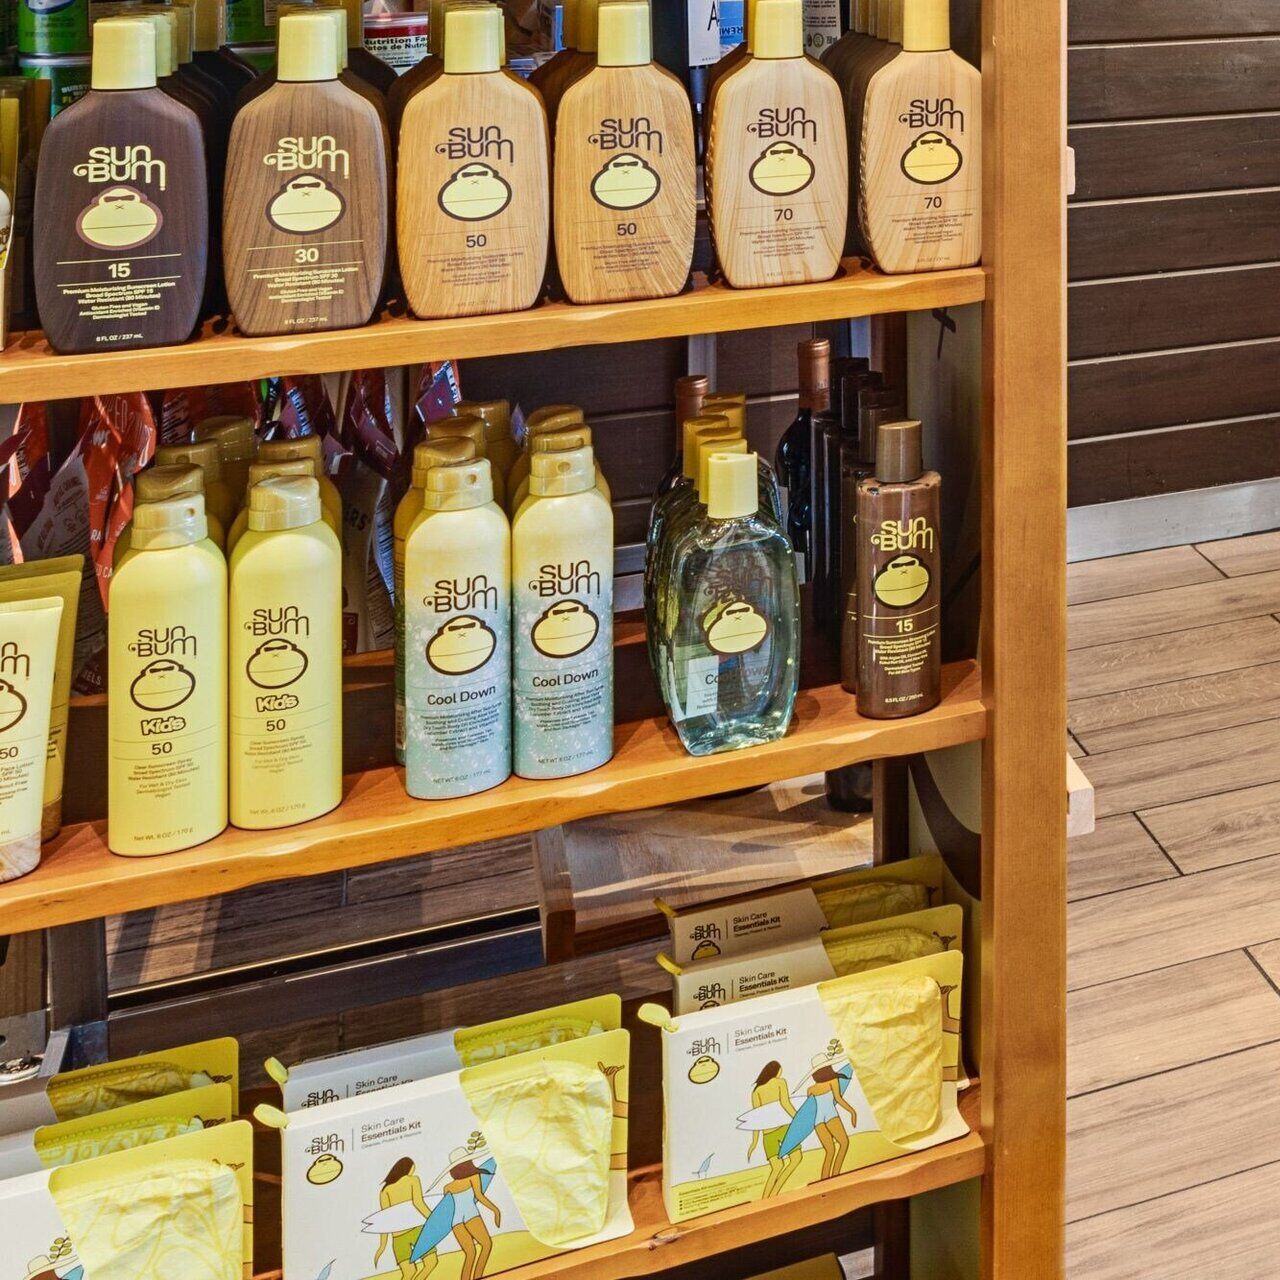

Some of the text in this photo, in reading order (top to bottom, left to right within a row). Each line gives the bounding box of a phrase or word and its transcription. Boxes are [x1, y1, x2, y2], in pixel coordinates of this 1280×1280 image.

[923, 195, 943, 210] 70
[773, 208, 794, 222] 70
[465, 234, 488, 248] 50
[295, 247, 320, 264] 30
[108, 262, 131, 279] 15
[895, 618, 914, 633] 15
[532, 668, 599, 688] Cool Down
[255, 693, 299, 713] Kids
[427, 685, 496, 707] Cool Down
[141, 716, 187, 736] Kids
[266, 718, 287, 732] 50
[151, 741, 173, 756] 50
[739, 970, 776, 984] Skin Care
[739, 975, 790, 993] Essentials Kit
[734, 1022, 773, 1038] Skin Care
[734, 1027, 788, 1047] Essentials Kit
[361, 1116, 405, 1133] Skin Care
[361, 1120, 422, 1142] Essentials Kit
